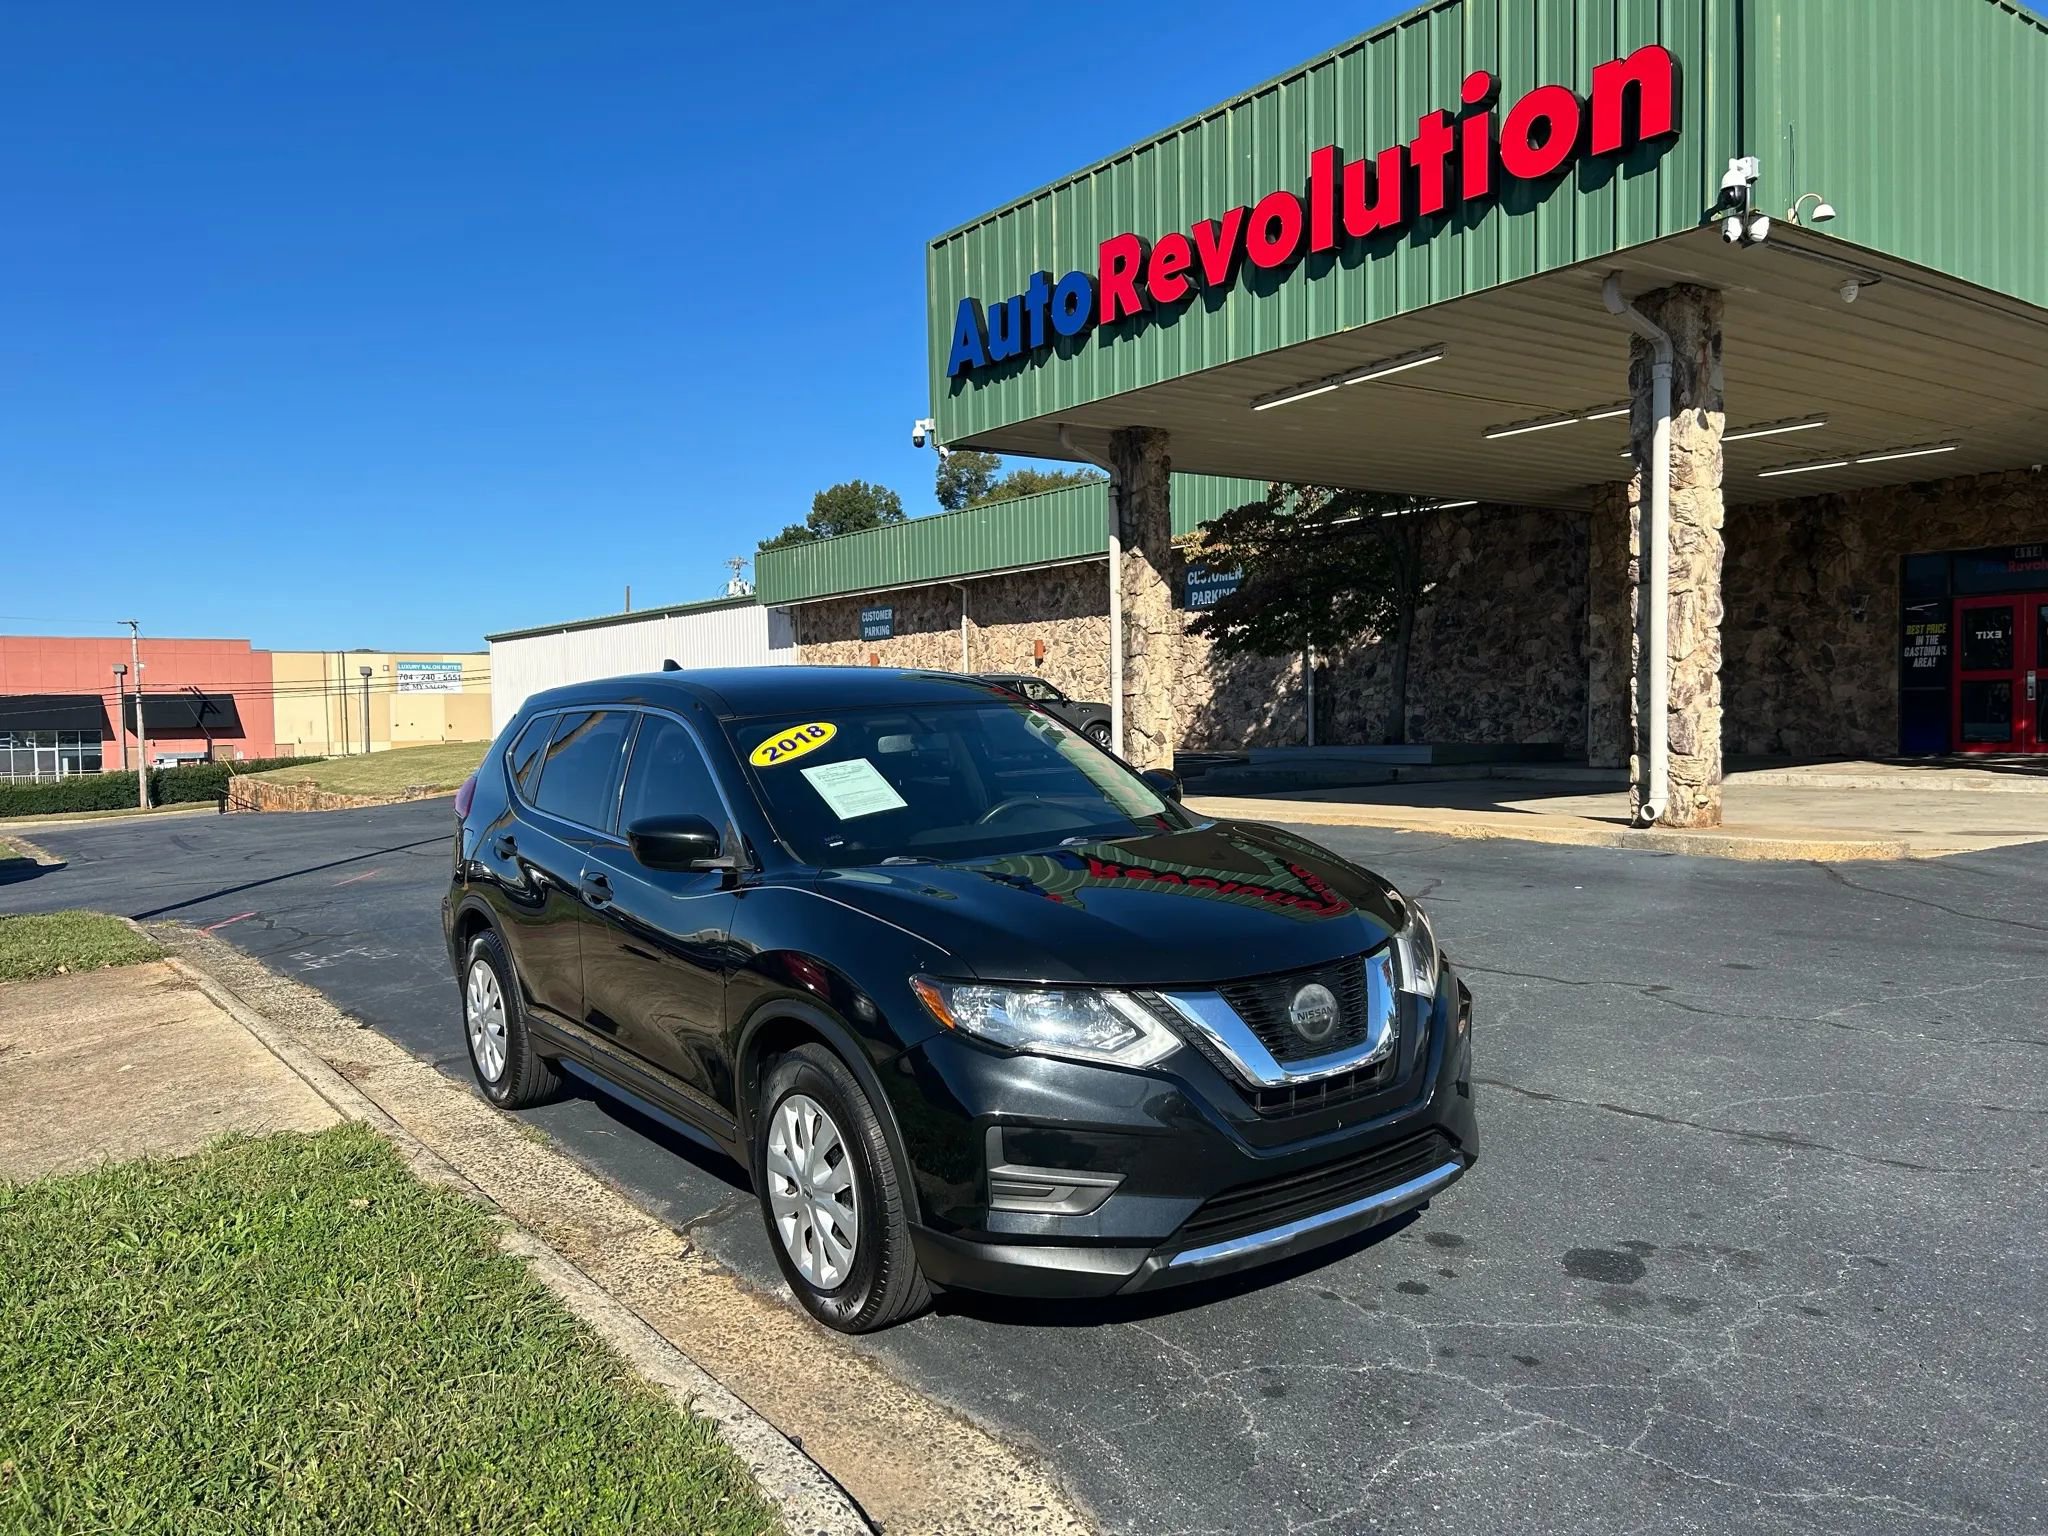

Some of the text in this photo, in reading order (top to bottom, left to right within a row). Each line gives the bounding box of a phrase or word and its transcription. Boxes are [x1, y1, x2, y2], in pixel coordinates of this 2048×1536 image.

[861, 609, 893, 622] CUSTOMER
[864, 625, 890, 637] PARKING
[1906, 624, 1947, 635] BEST PRICE
[1915, 635, 1939, 646] IN THE
[1904, 646, 1947, 657] GASTONIA'S
[1912, 657, 1936, 668] AREA!
[399, 673, 413, 681] 704
[420, 673, 436, 681] 240
[762, 725, 826, 762] 2018
[1296, 1005, 1333, 1021] NISSAN
